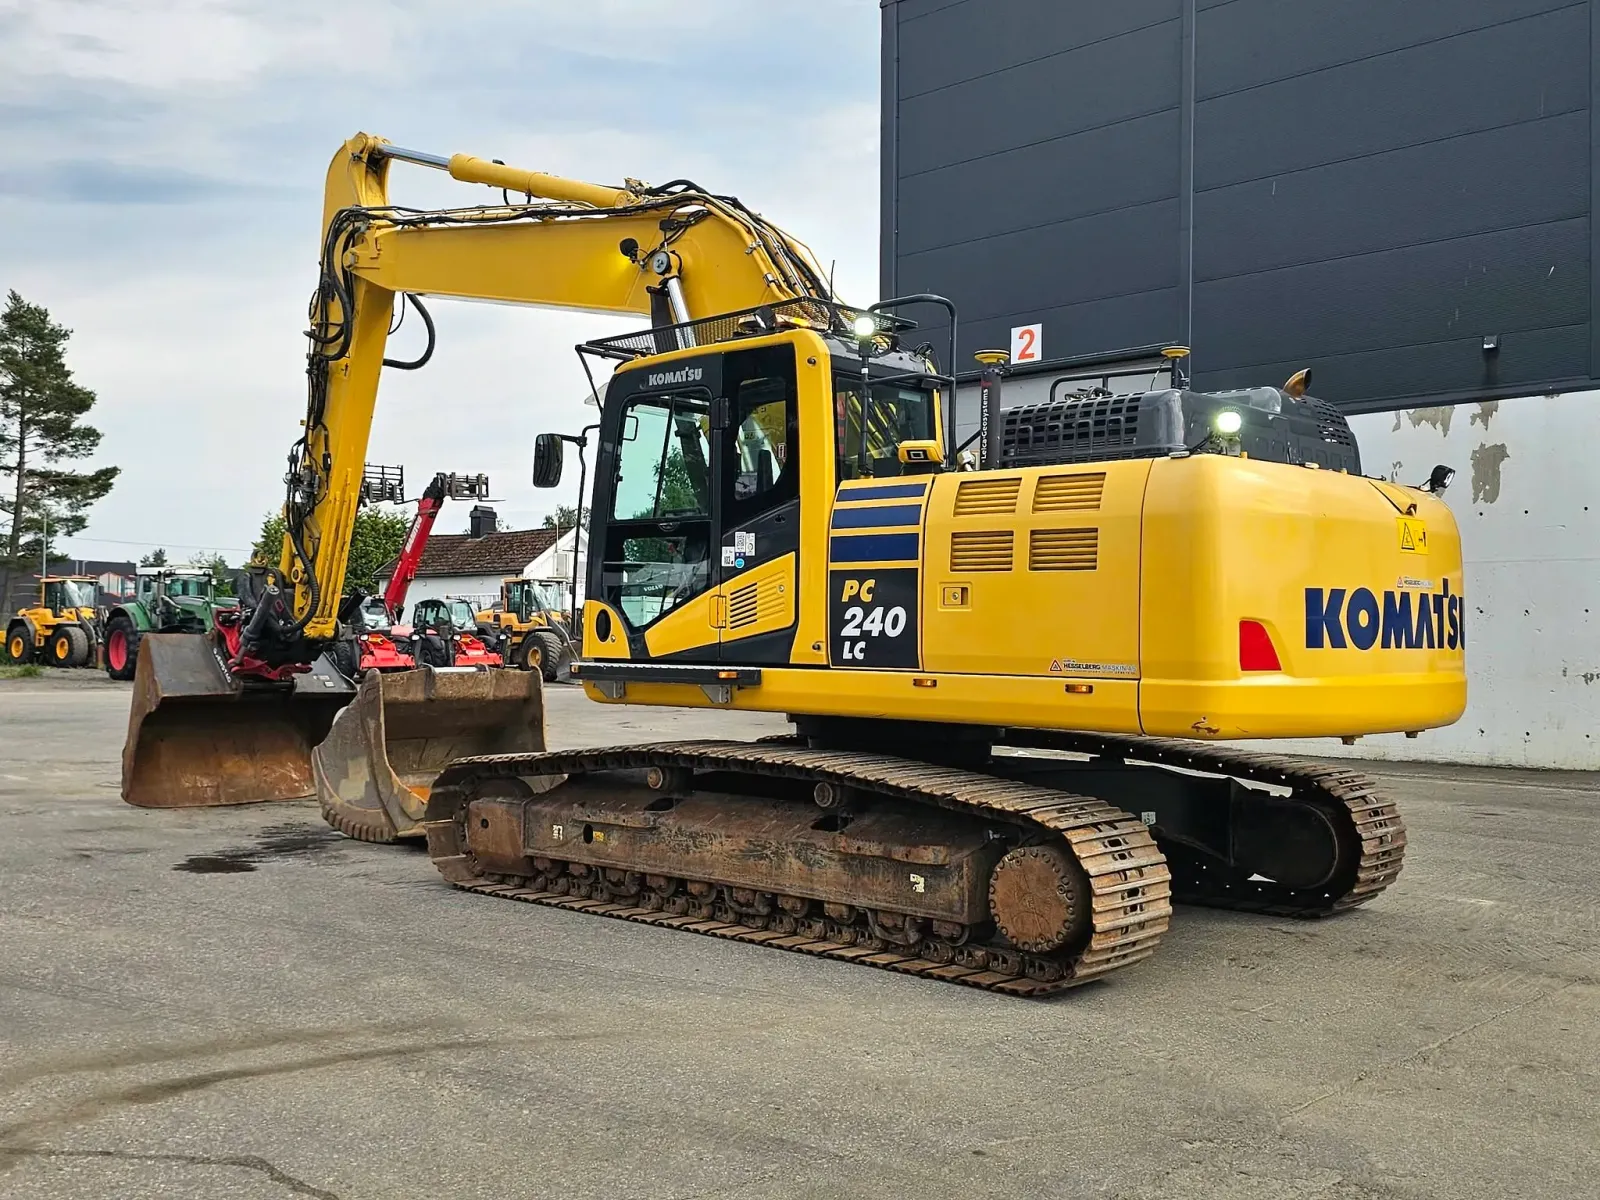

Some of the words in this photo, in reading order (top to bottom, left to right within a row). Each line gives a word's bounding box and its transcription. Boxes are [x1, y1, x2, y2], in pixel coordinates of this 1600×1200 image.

[1018, 328, 1035, 360] 2
[648, 366, 703, 386] KOMATSU
[841, 578, 876, 602] PC
[840, 605, 907, 638] 240
[842, 641, 866, 660] LC
